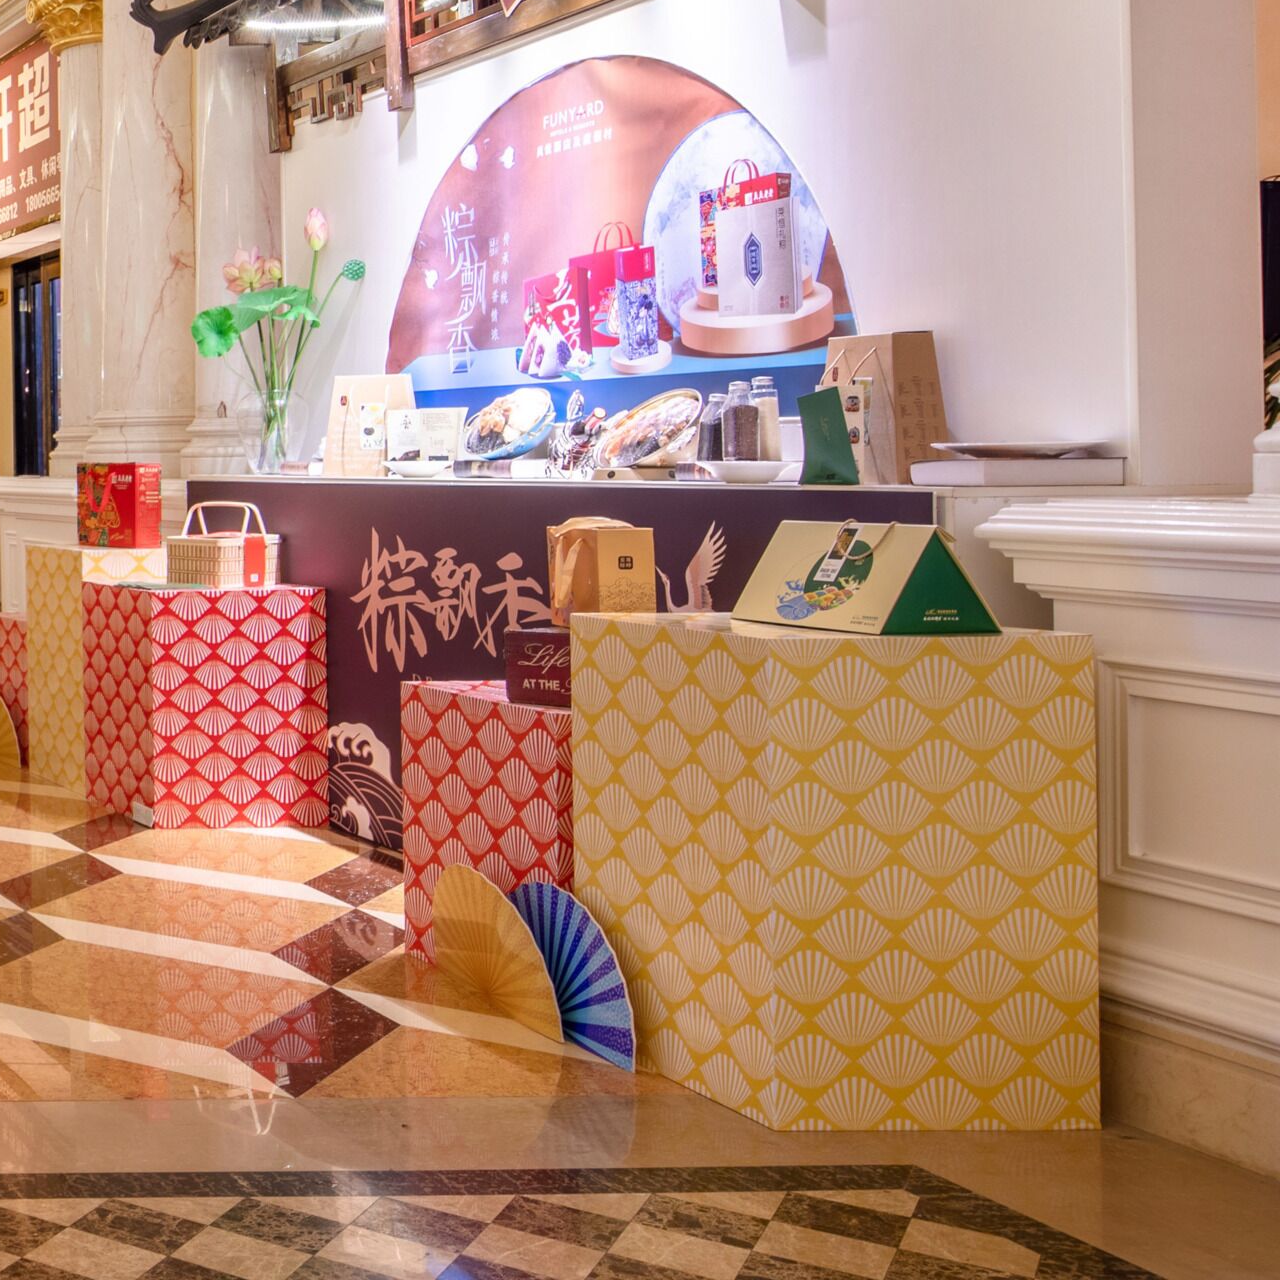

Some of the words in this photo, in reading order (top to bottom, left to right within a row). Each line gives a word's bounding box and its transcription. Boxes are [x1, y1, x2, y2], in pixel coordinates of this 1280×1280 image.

[543, 100, 604, 130] FUNYARD
[25, 184, 63, 214] 18005665
[440, 202, 488, 374] 粽飘香
[517, 642, 571, 675] Life
[522, 678, 537, 689] AT
[538, 679, 561, 691] THE
